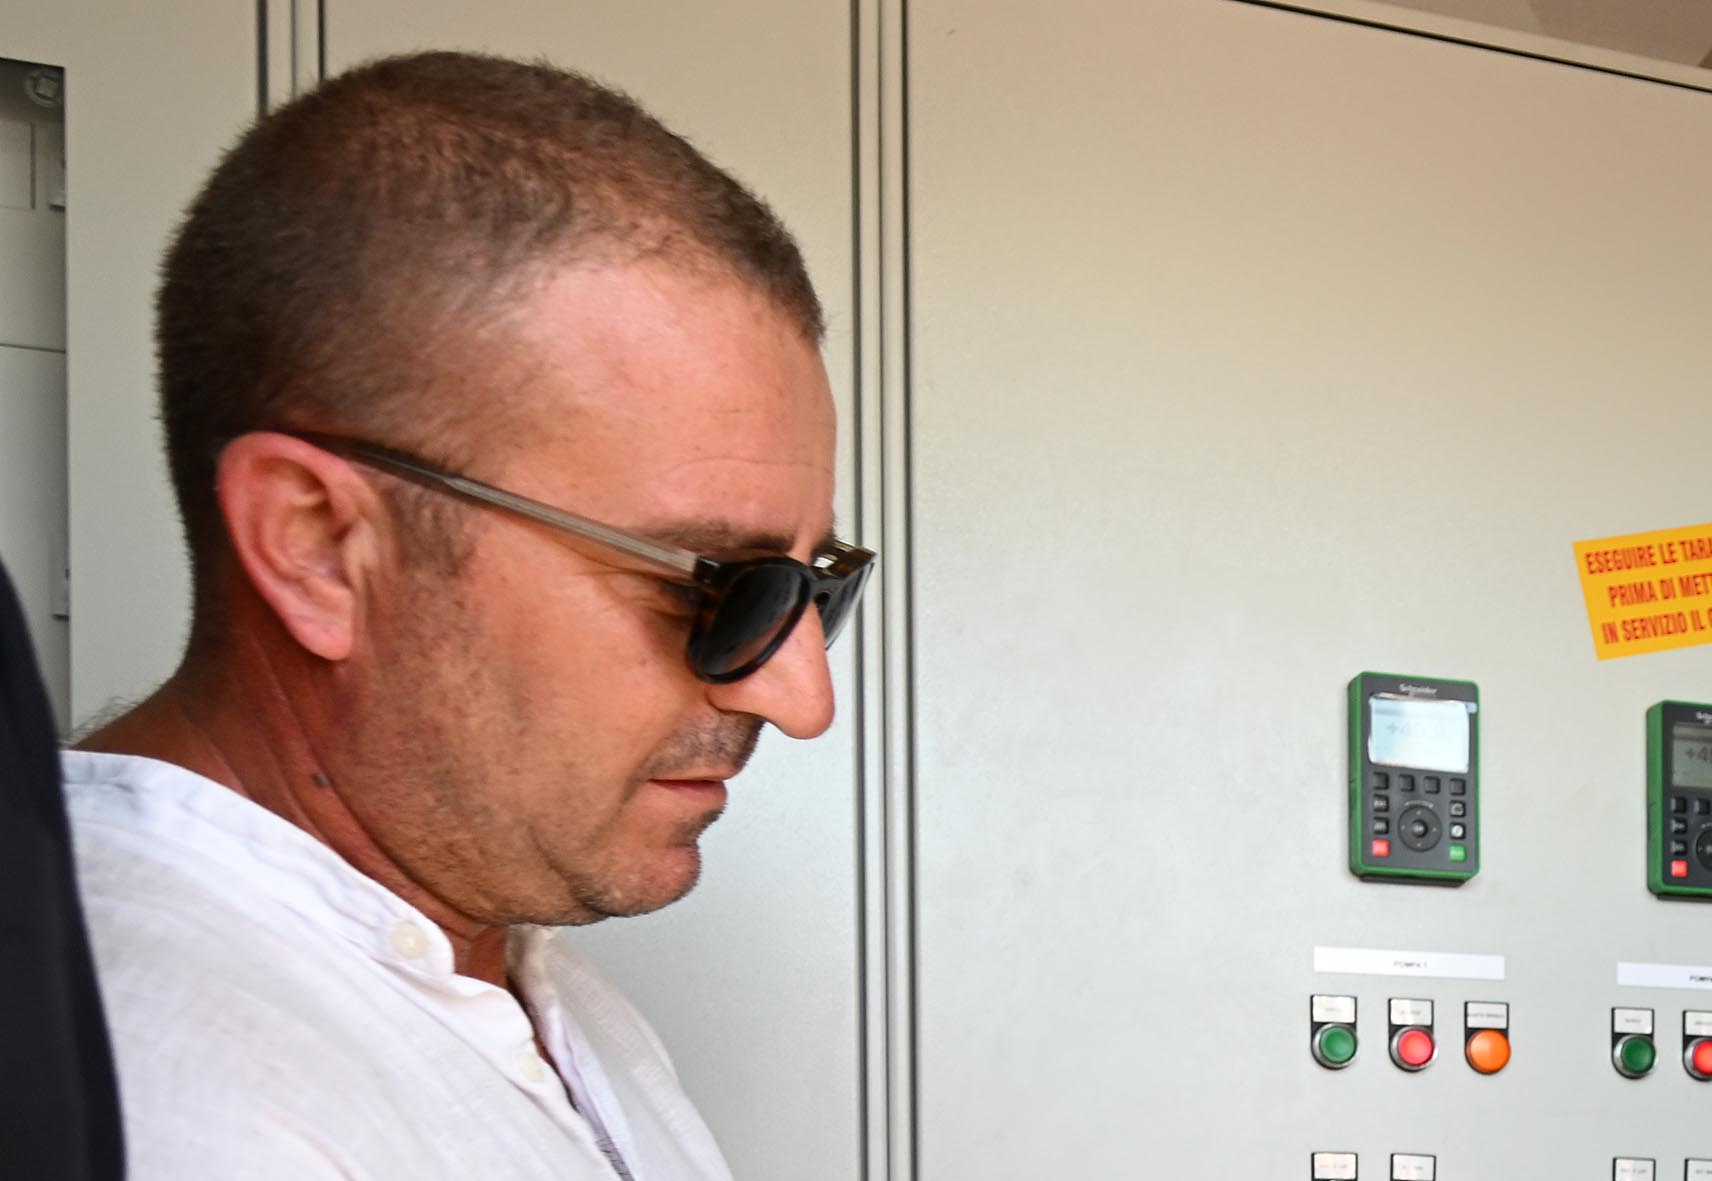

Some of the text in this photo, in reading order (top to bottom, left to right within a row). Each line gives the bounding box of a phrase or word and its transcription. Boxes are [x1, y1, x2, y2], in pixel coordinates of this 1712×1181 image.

[1585, 545, 1657, 575] ESEGUIRE
[1659, 541, 1678, 565] LE
[1608, 580, 1658, 608] PRIMA
[1660, 577, 1676, 600] DI
[1602, 621, 1620, 645] IN
[1621, 611, 1688, 641] SERVIZIO
[1691, 610, 1706, 631] IL
